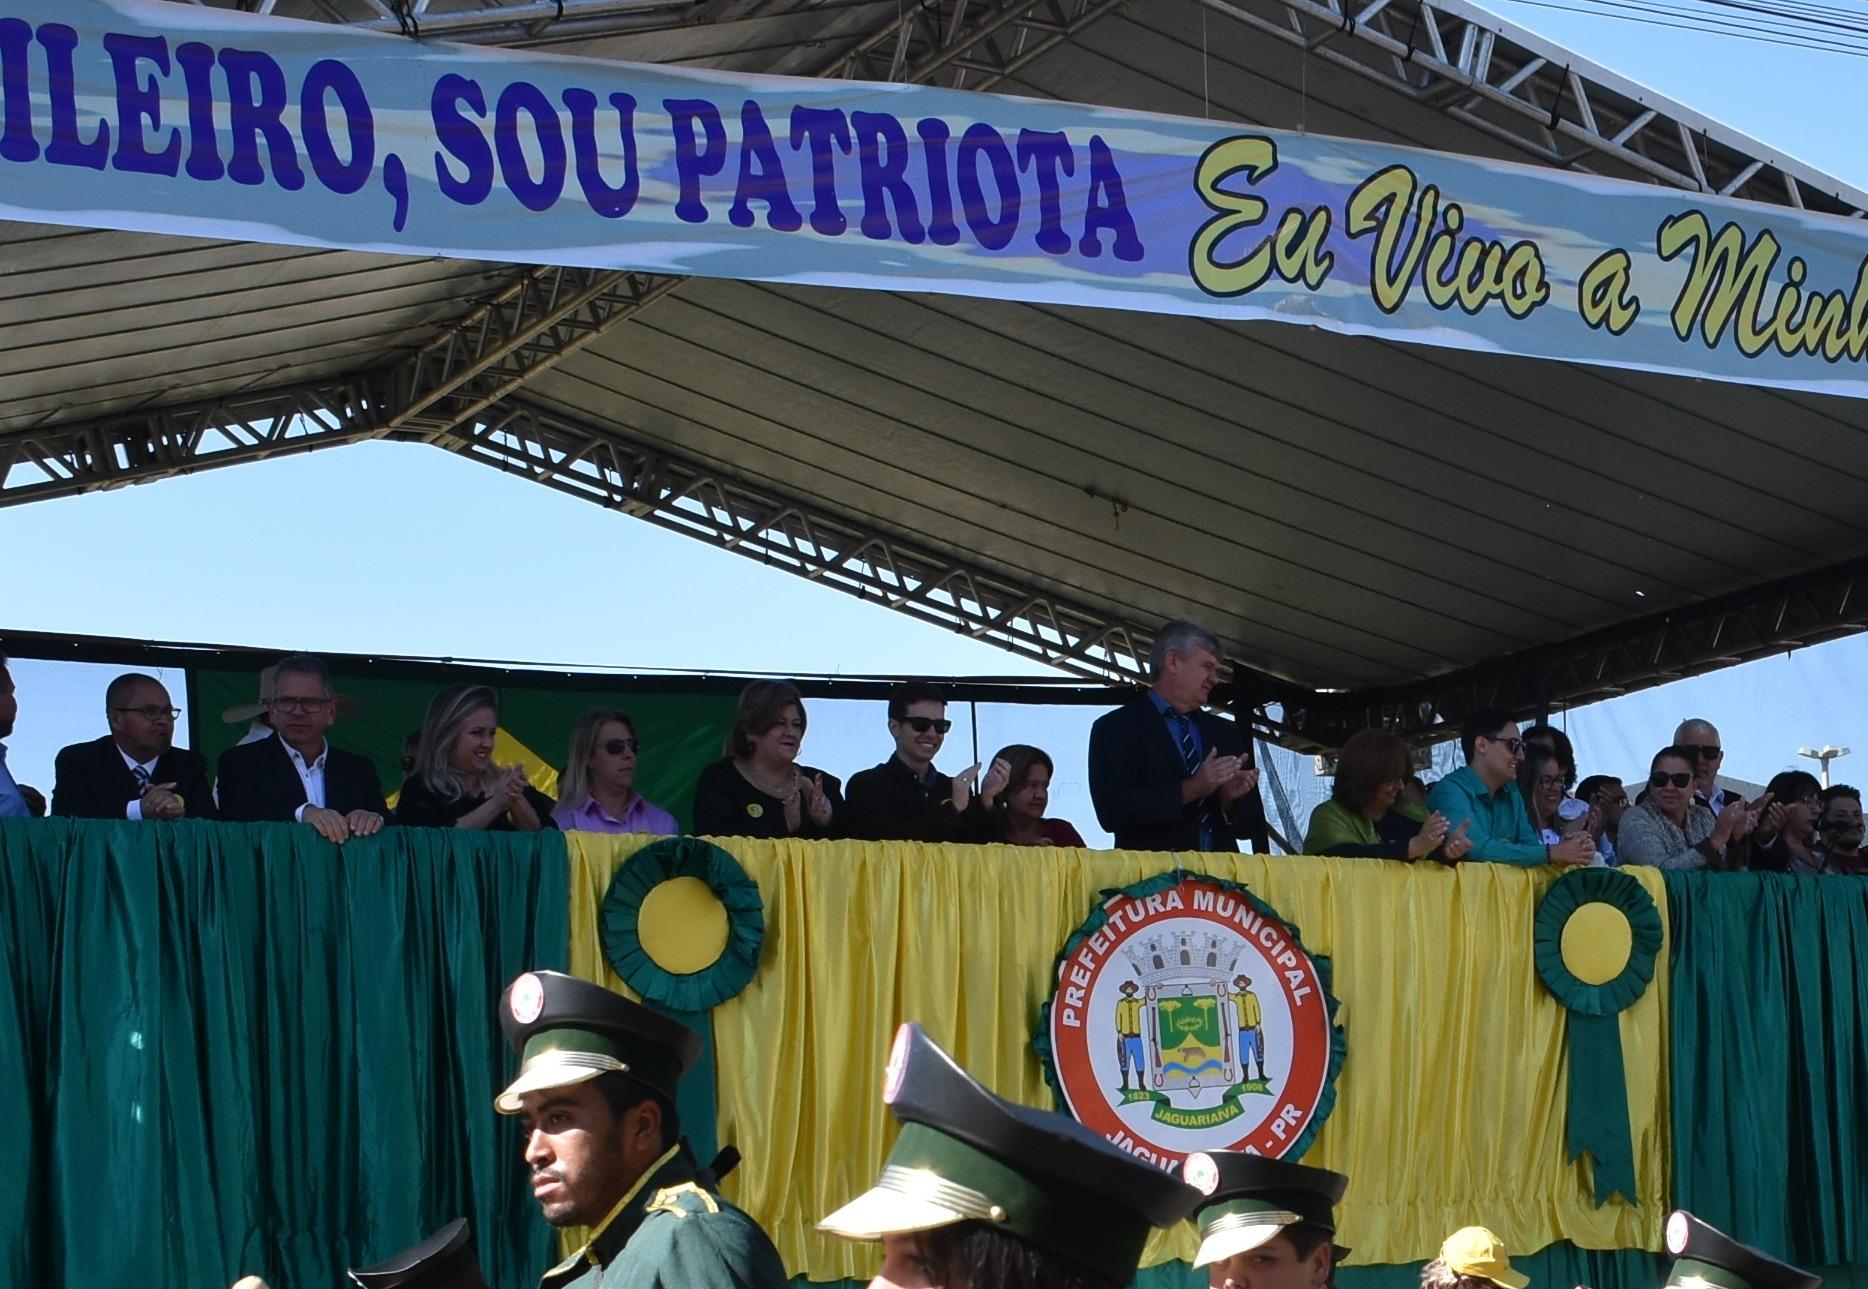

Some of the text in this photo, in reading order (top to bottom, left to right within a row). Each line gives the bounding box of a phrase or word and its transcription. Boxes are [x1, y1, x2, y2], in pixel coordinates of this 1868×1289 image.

[0, 17, 408, 231] ILEIRO,
[434, 73, 638, 218] SOU
[660, 98, 1146, 261] PATRIOTA
[1190, 134, 1333, 298] Eu
[1347, 165, 1552, 317] Vivo
[1578, 249, 1641, 336] a
[1062, 889, 1312, 1028] PREFEITURA MUNICIPAL
[1270, 1103, 1303, 1141] PR
